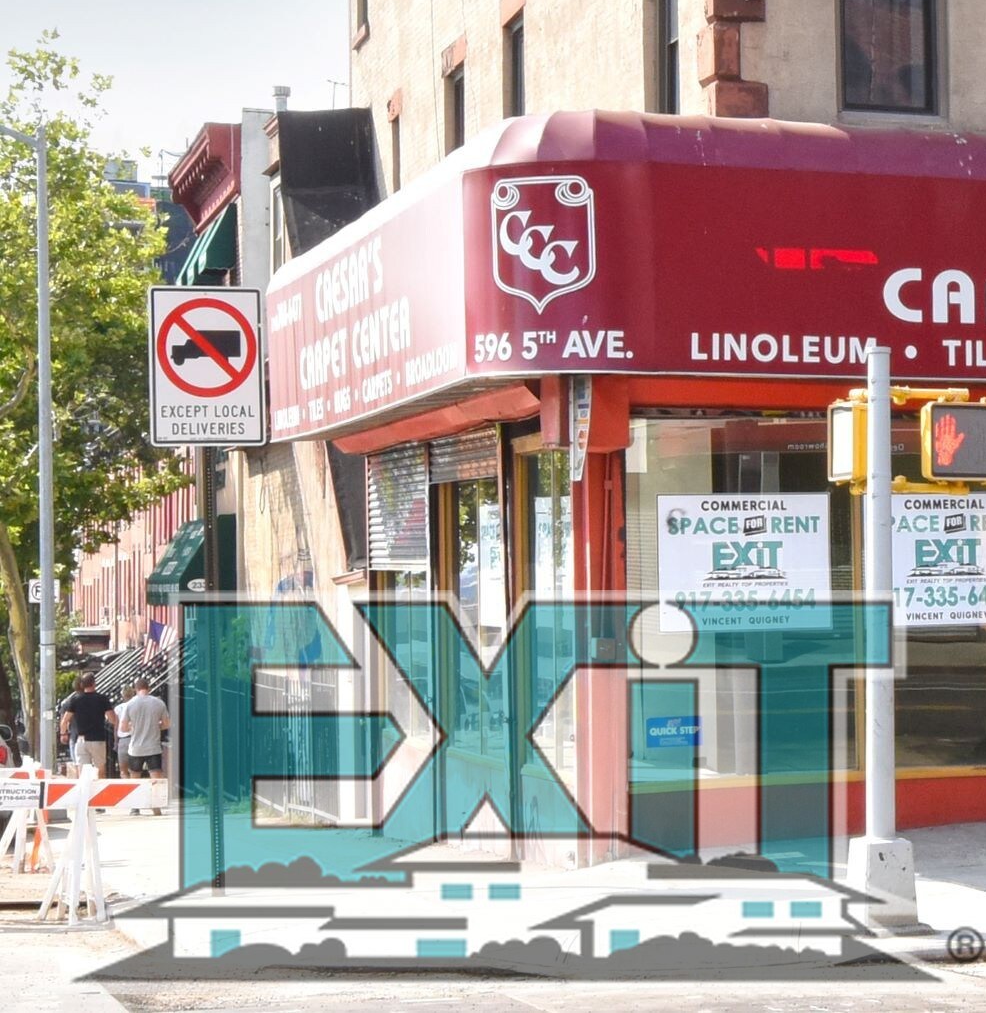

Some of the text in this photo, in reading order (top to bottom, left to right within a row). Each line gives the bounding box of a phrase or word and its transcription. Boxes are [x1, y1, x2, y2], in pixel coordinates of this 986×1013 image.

[315, 236, 383, 323] CAESAR'S
[300, 328, 347, 389] CARPET
[352, 296, 411, 368] CENTER
[474, 330, 633, 363] 596 5TH AVE.
[690, 332, 877, 364] LINOLEUM
[161, 405, 255, 418] EXCEPT LOCAL
[172, 423, 245, 435] DELIVERIES
[700, 500, 787, 511] COMMERCIAL
[904, 499, 985, 510] COMMERCIAL
[667, 515, 820, 535] SPACE FOR RENT
[891, 514, 940, 532] ACE
[946, 516, 962, 528] FOR
[702, 615, 790, 625] VINCENT QUIGNEY
[906, 612, 944, 620] VINCENT
[649, 726, 702, 736] QUICK STEP
